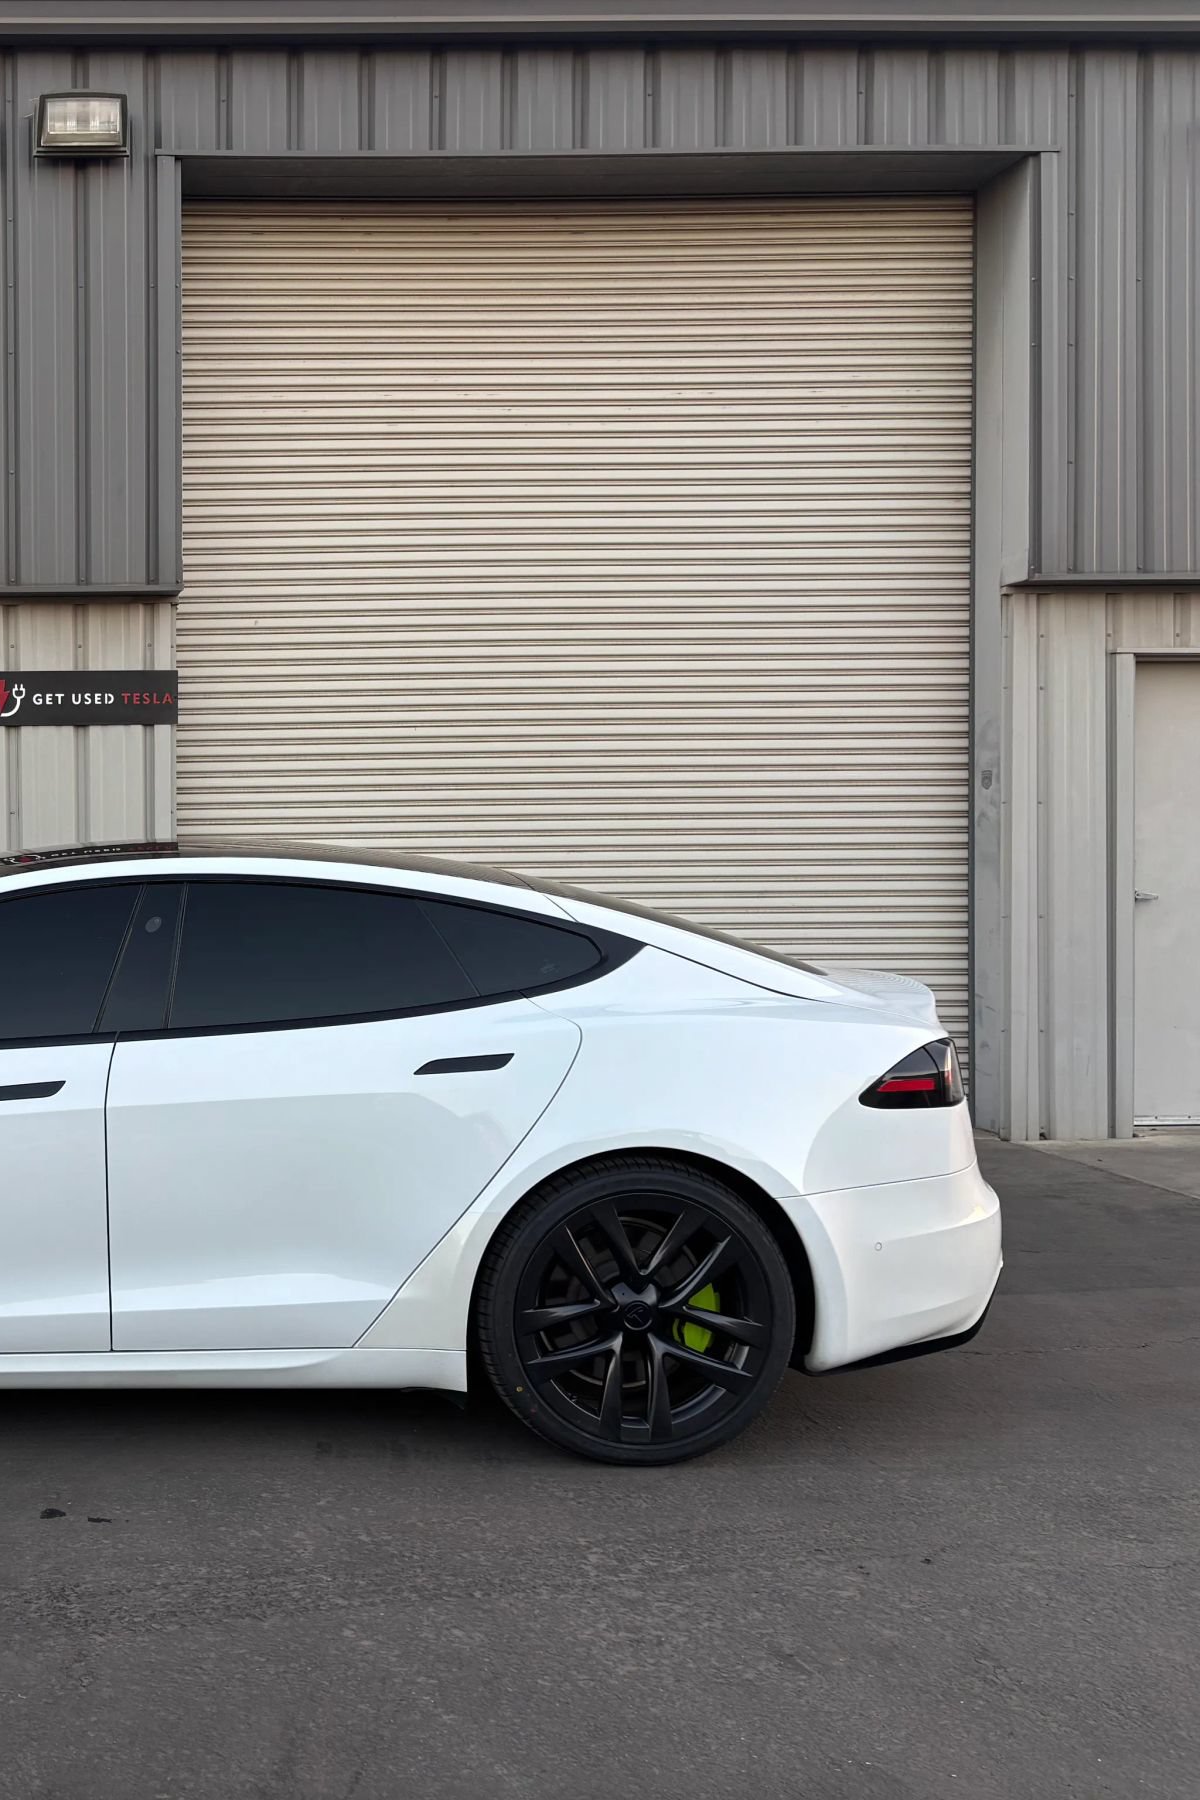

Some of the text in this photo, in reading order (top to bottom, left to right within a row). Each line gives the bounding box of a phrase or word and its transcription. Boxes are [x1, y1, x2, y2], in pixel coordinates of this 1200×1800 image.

[32, 693, 174, 705] GET USED TESLA
